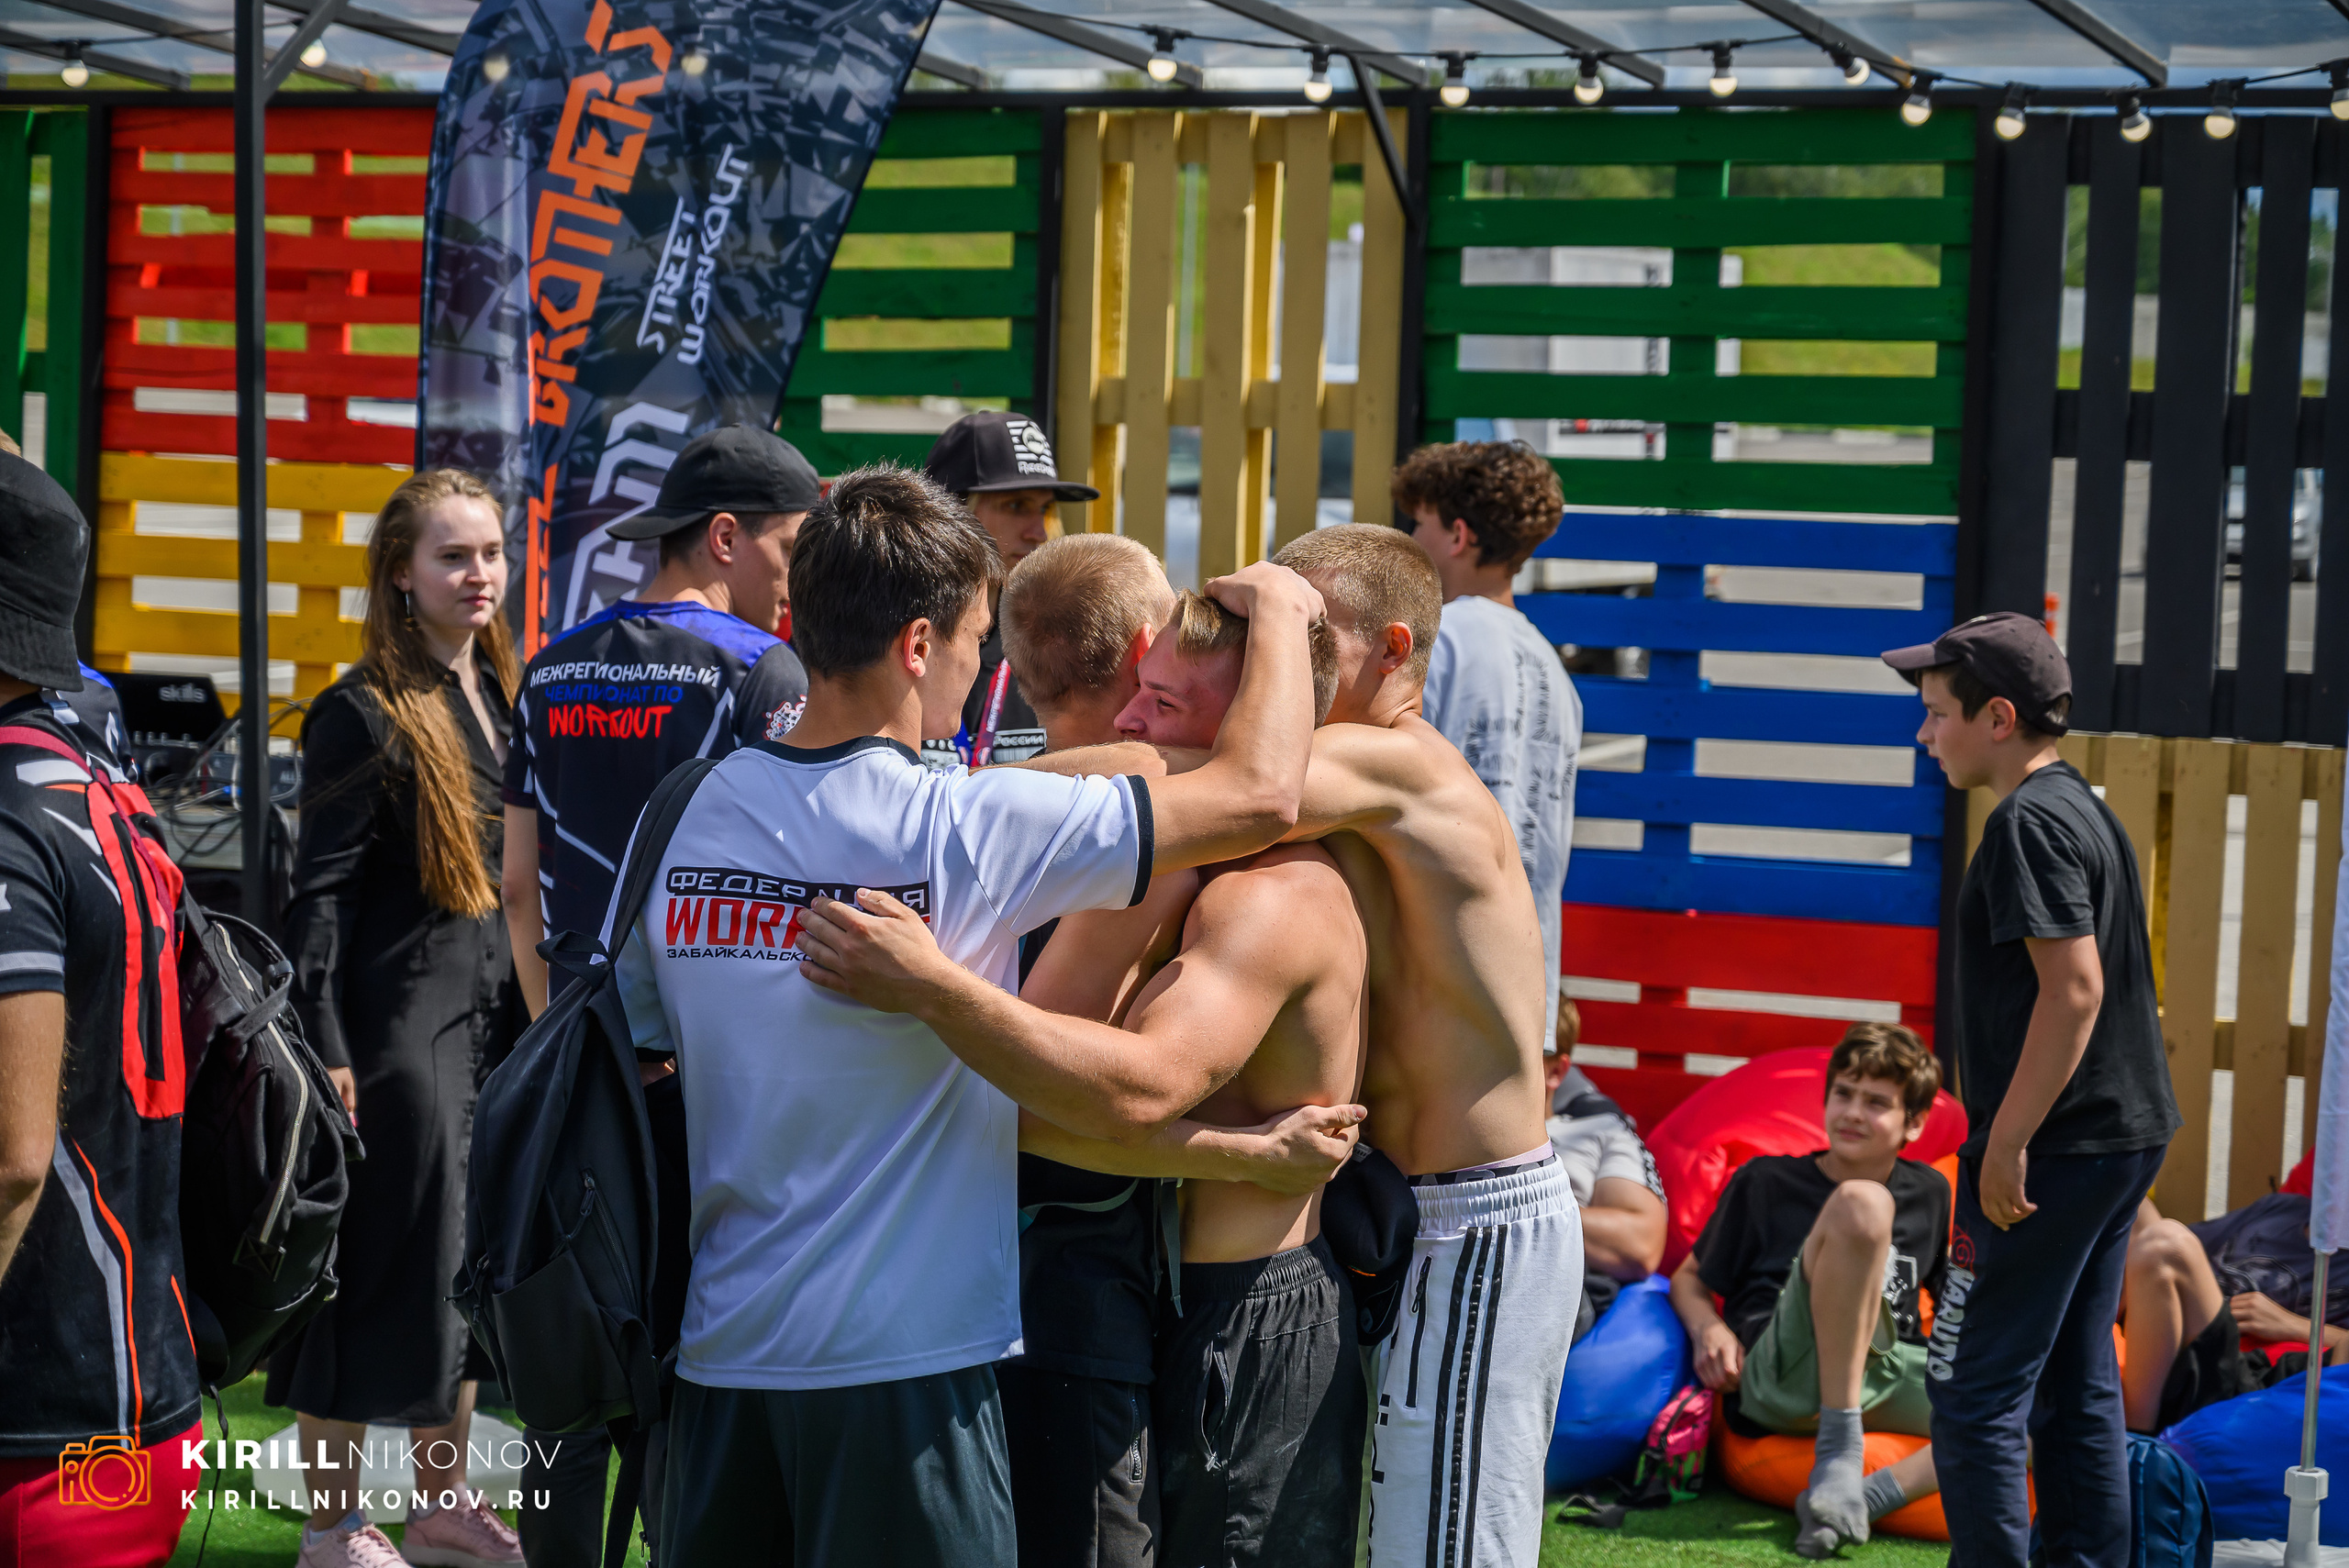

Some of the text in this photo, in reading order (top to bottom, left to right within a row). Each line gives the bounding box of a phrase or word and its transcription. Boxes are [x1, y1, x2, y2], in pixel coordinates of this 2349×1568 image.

[676, 142, 749, 365] WORKOUT
[636, 195, 696, 354] STREET
[529, 661, 721, 688] МЕЖРЕГИОНАЛЬНЫЙ
[159, 683, 206, 703] skills
[545, 684, 684, 704] ЧЕМПИОНАТ ПО
[549, 705, 672, 738] WORKOUT
[1925, 1262, 1976, 1382] NARUTO
